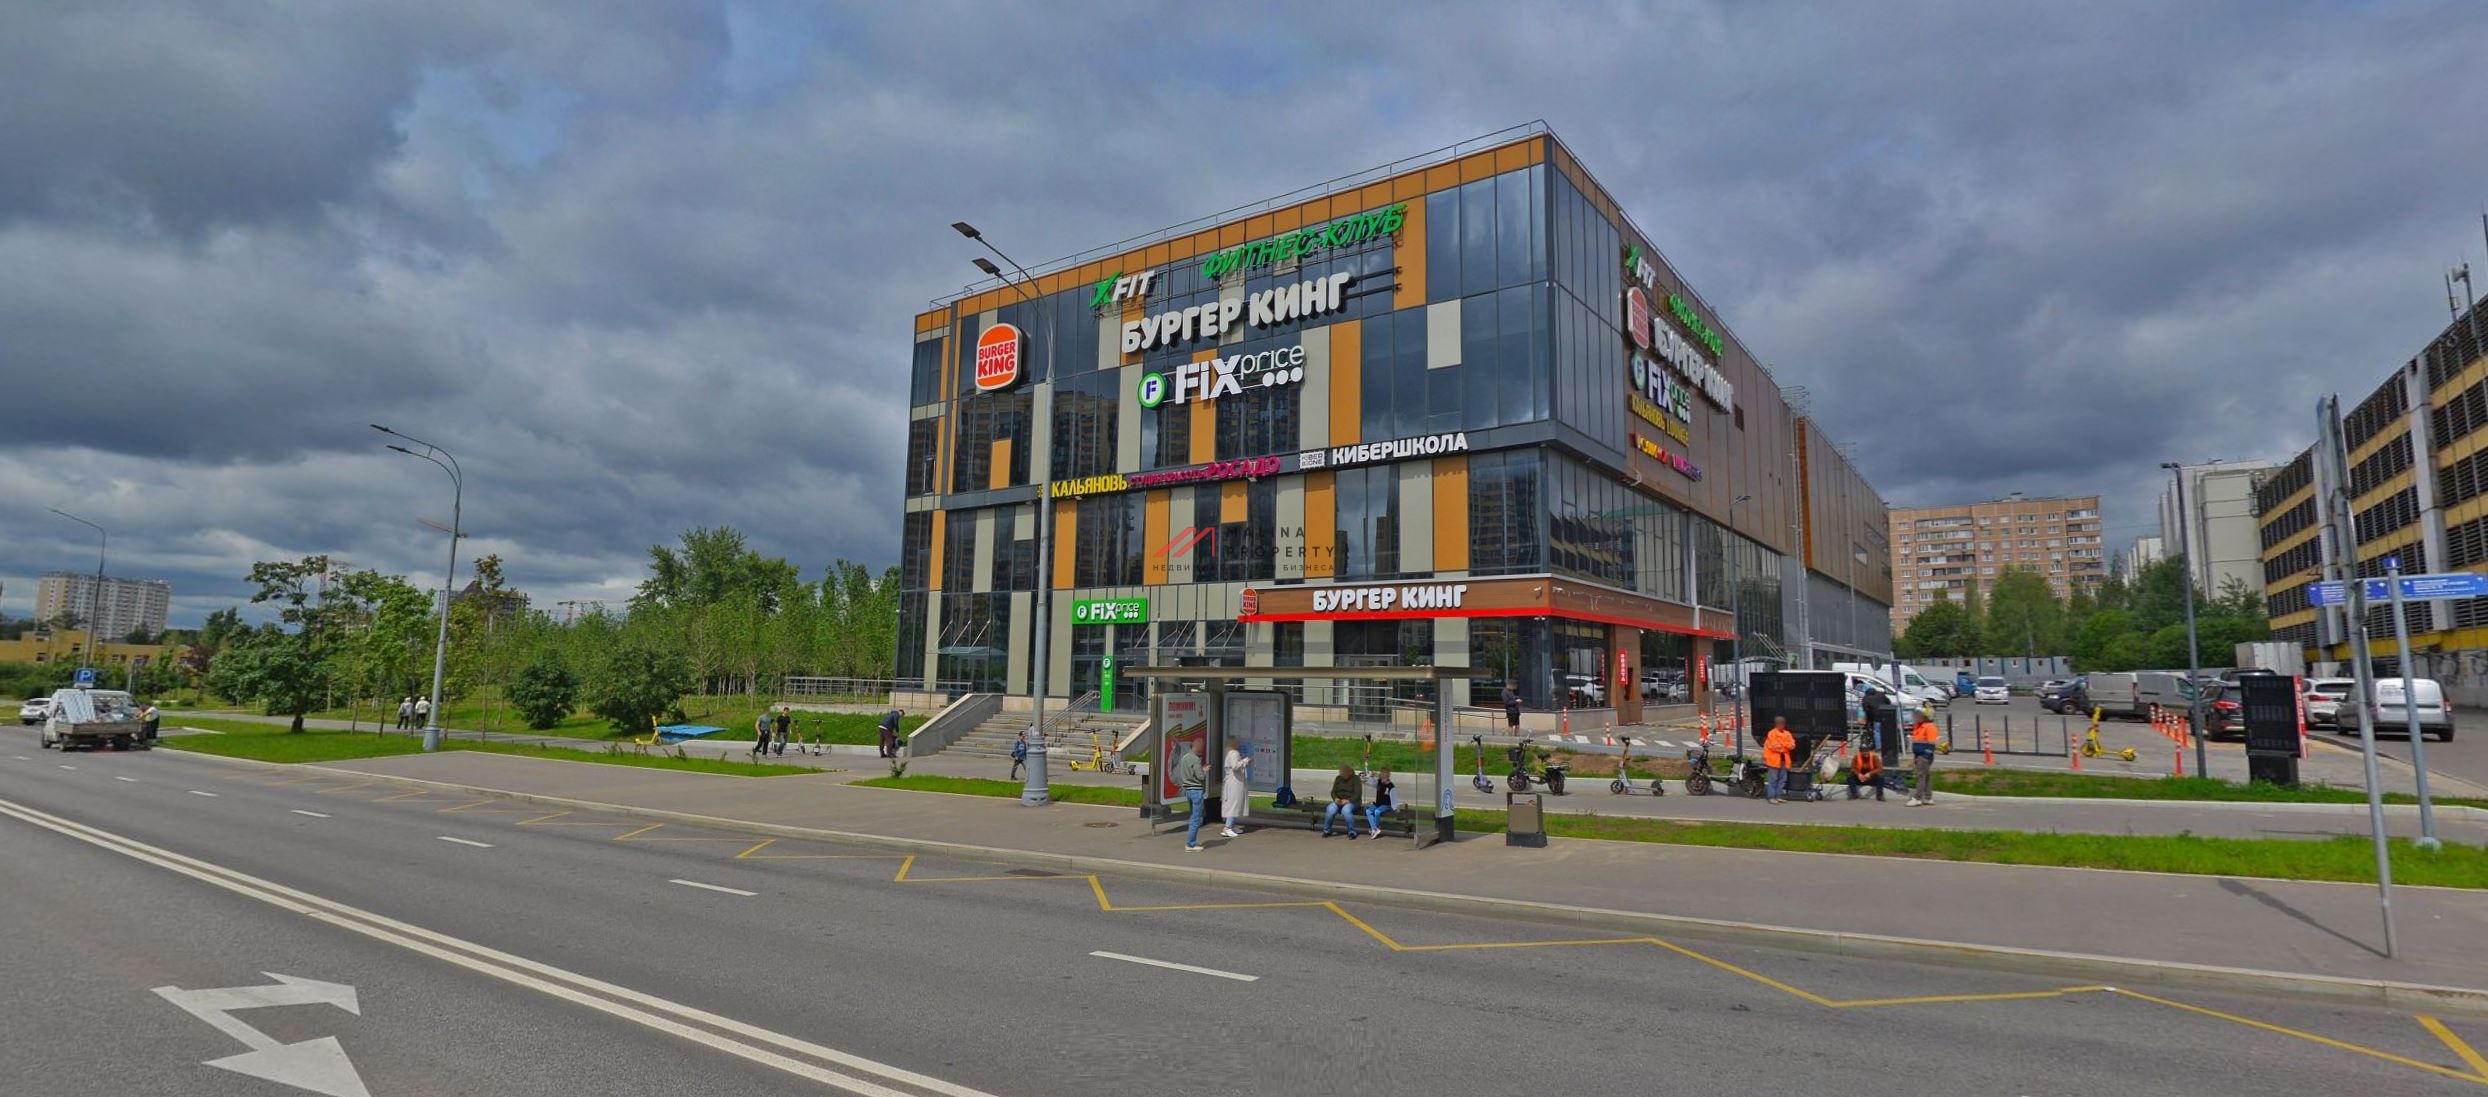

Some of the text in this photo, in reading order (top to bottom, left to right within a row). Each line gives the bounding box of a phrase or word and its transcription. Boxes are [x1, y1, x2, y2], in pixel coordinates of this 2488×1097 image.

[1201, 204, 1407, 278] ФИТНЕС-КЛУБ
[1122, 272, 1350, 353] БУРГЕР КИНГ
[978, 354, 1015, 377] KING
[979, 342, 1015, 360] BURGER
[1241, 345, 1305, 379] price
[1654, 317, 1704, 388] БУРГЕР
[1332, 432, 1468, 465] КИБЕРШКОЛА
[1207, 455, 1280, 480] РОСАДО
[1116, 602, 1140, 614] price
[1313, 585, 1467, 611] БУРГЕР КИНГ
